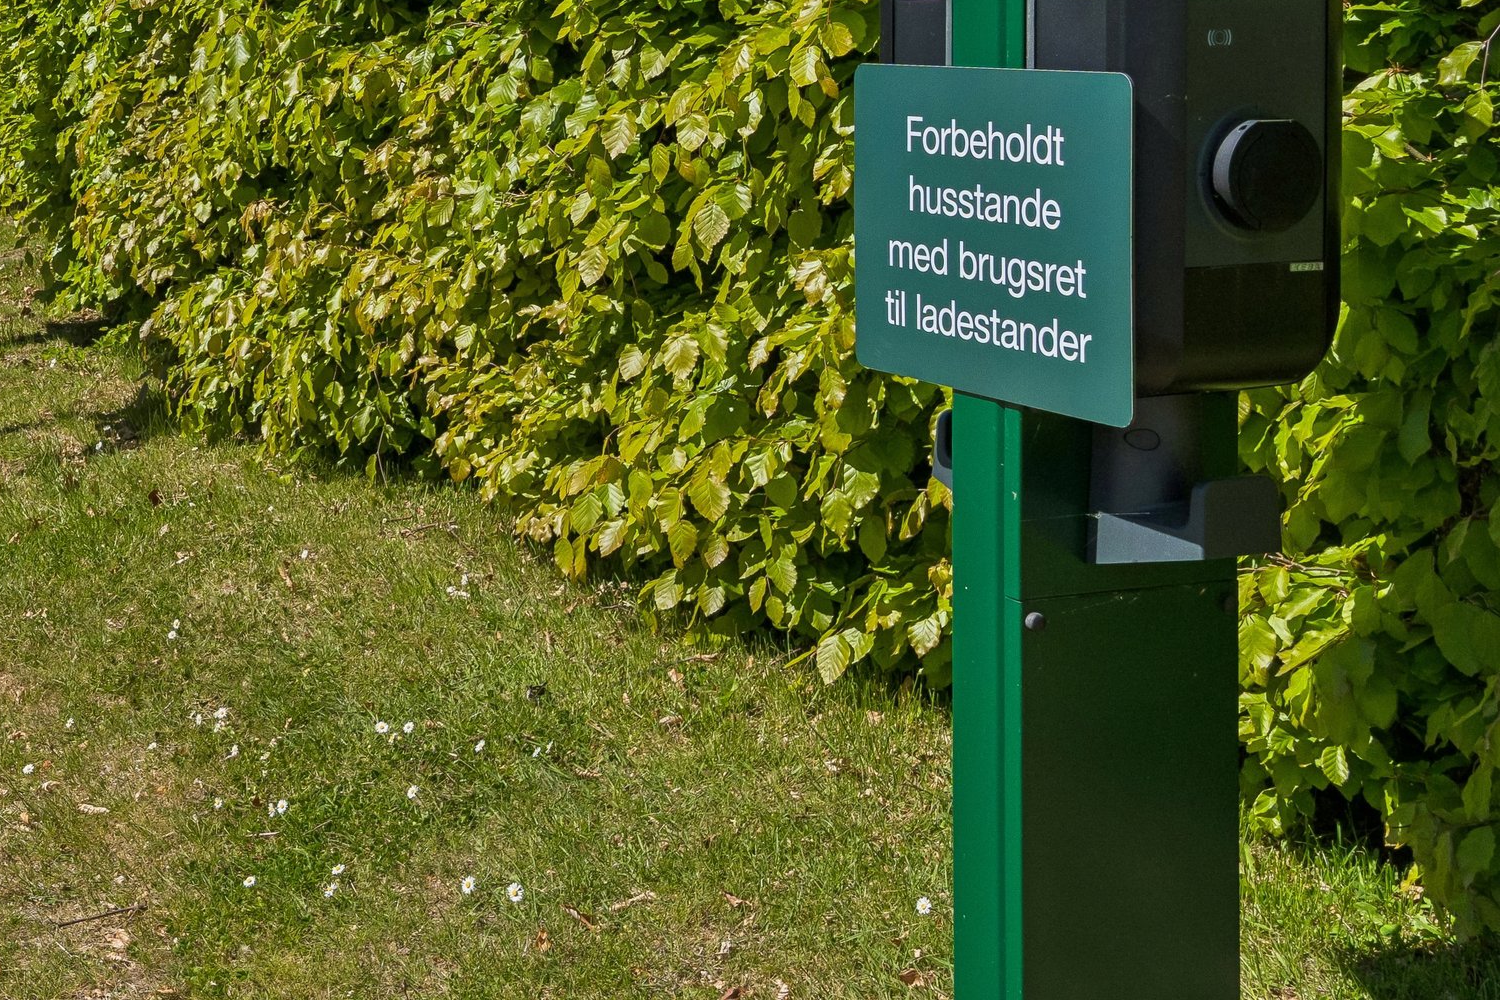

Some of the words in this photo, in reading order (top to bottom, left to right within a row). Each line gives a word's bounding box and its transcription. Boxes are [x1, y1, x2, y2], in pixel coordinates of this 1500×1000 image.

[906, 115, 1065, 166] Forbeholdt
[909, 174, 1062, 230] husstande
[889, 238, 948, 275] med
[959, 240, 1087, 299] brugsret
[884, 289, 906, 327] til
[916, 293, 1093, 363] ladestander
